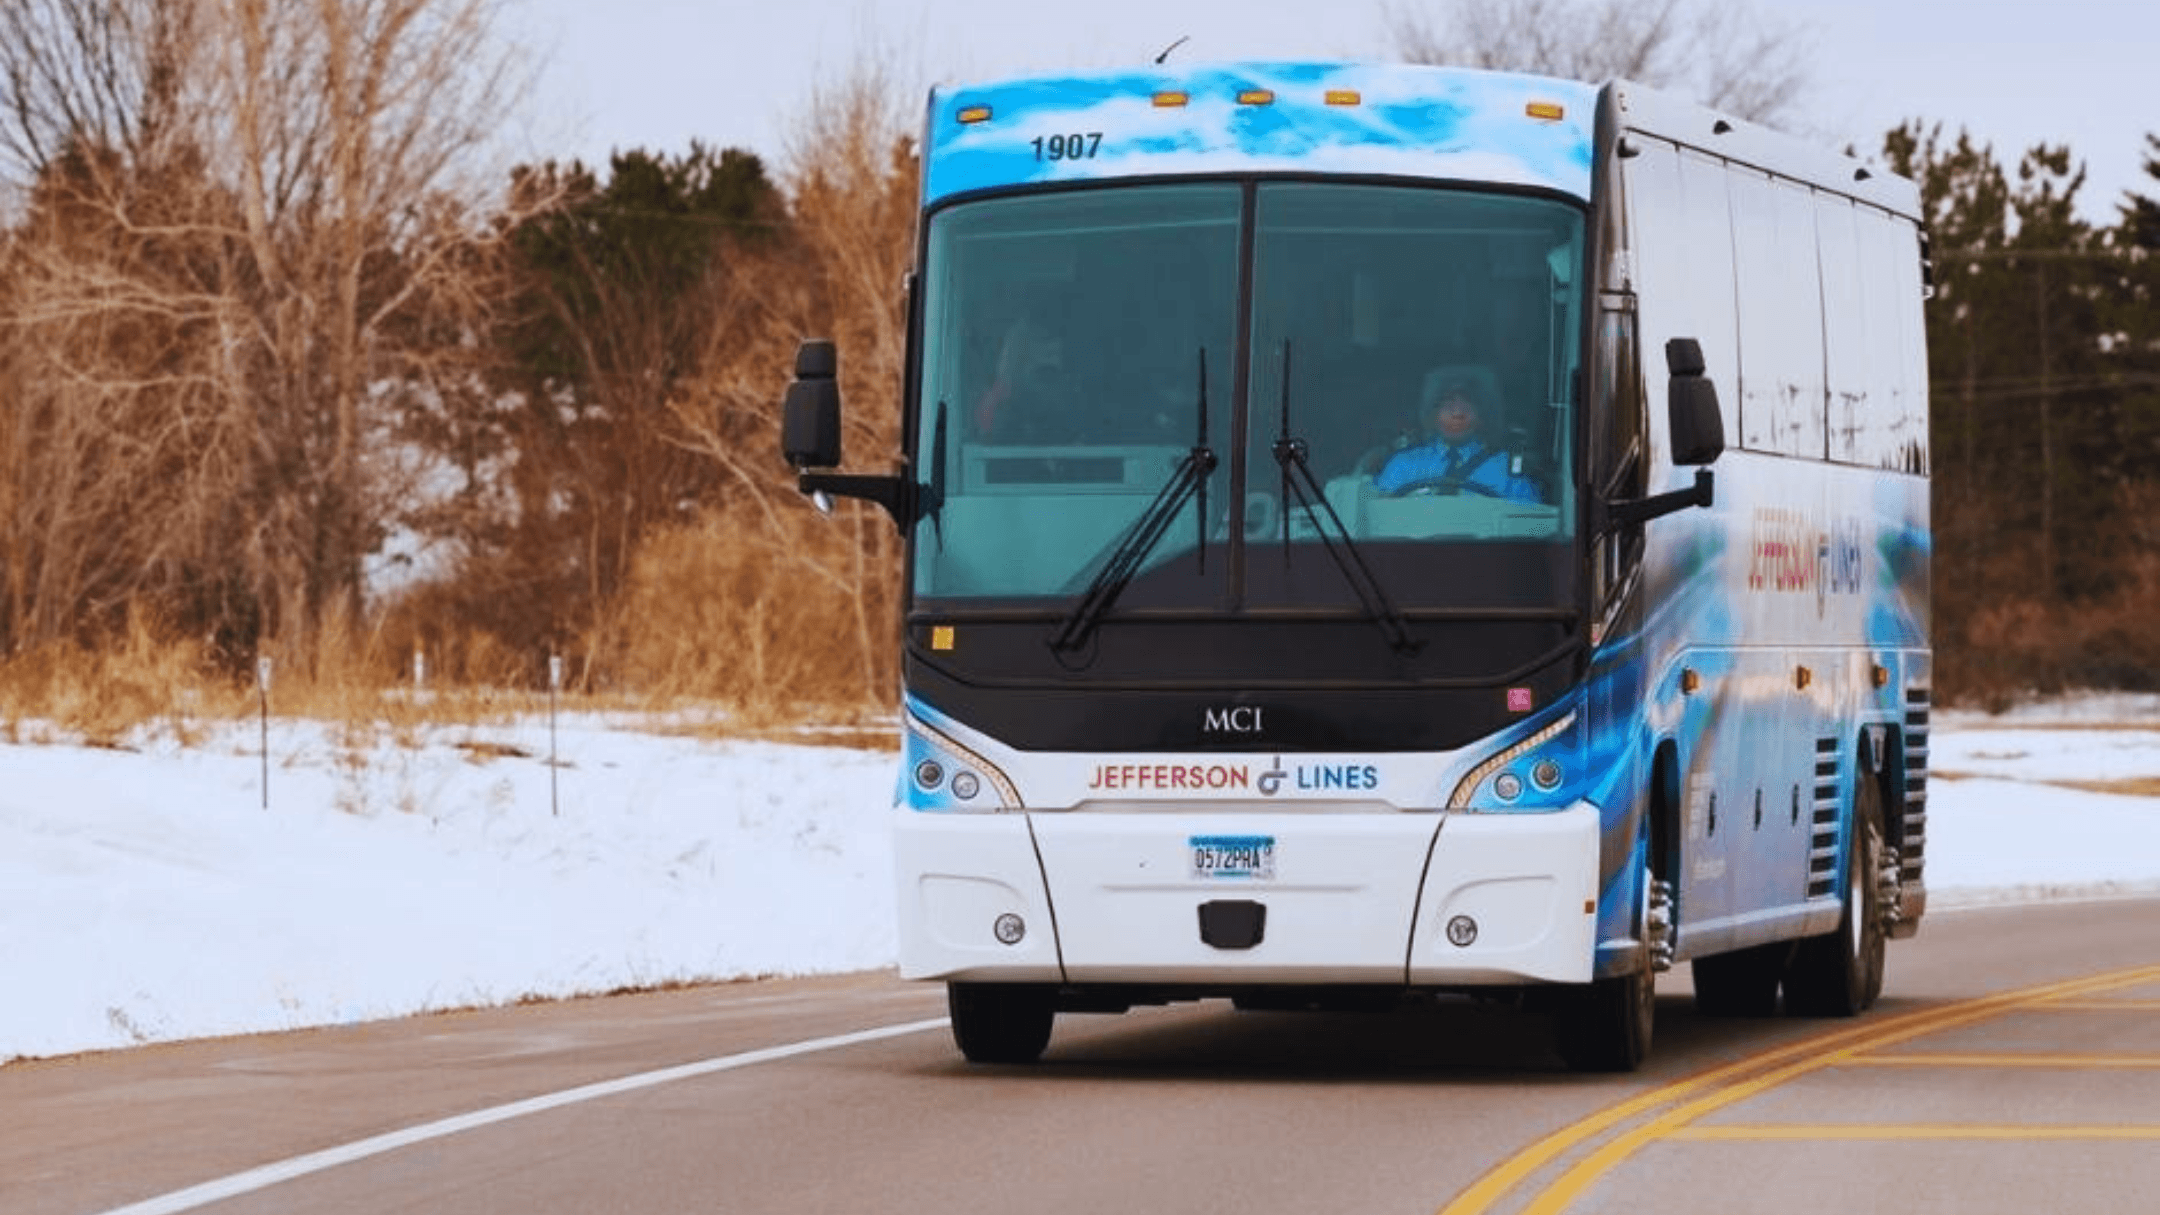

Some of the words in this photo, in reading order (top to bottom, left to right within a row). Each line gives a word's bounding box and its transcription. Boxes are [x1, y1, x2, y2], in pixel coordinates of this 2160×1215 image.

[1031, 132, 1103, 162] 1907
[1203, 707, 1263, 732] MCI
[1089, 766, 1248, 788] JEFFERSON
[1297, 766, 1378, 789] LINES
